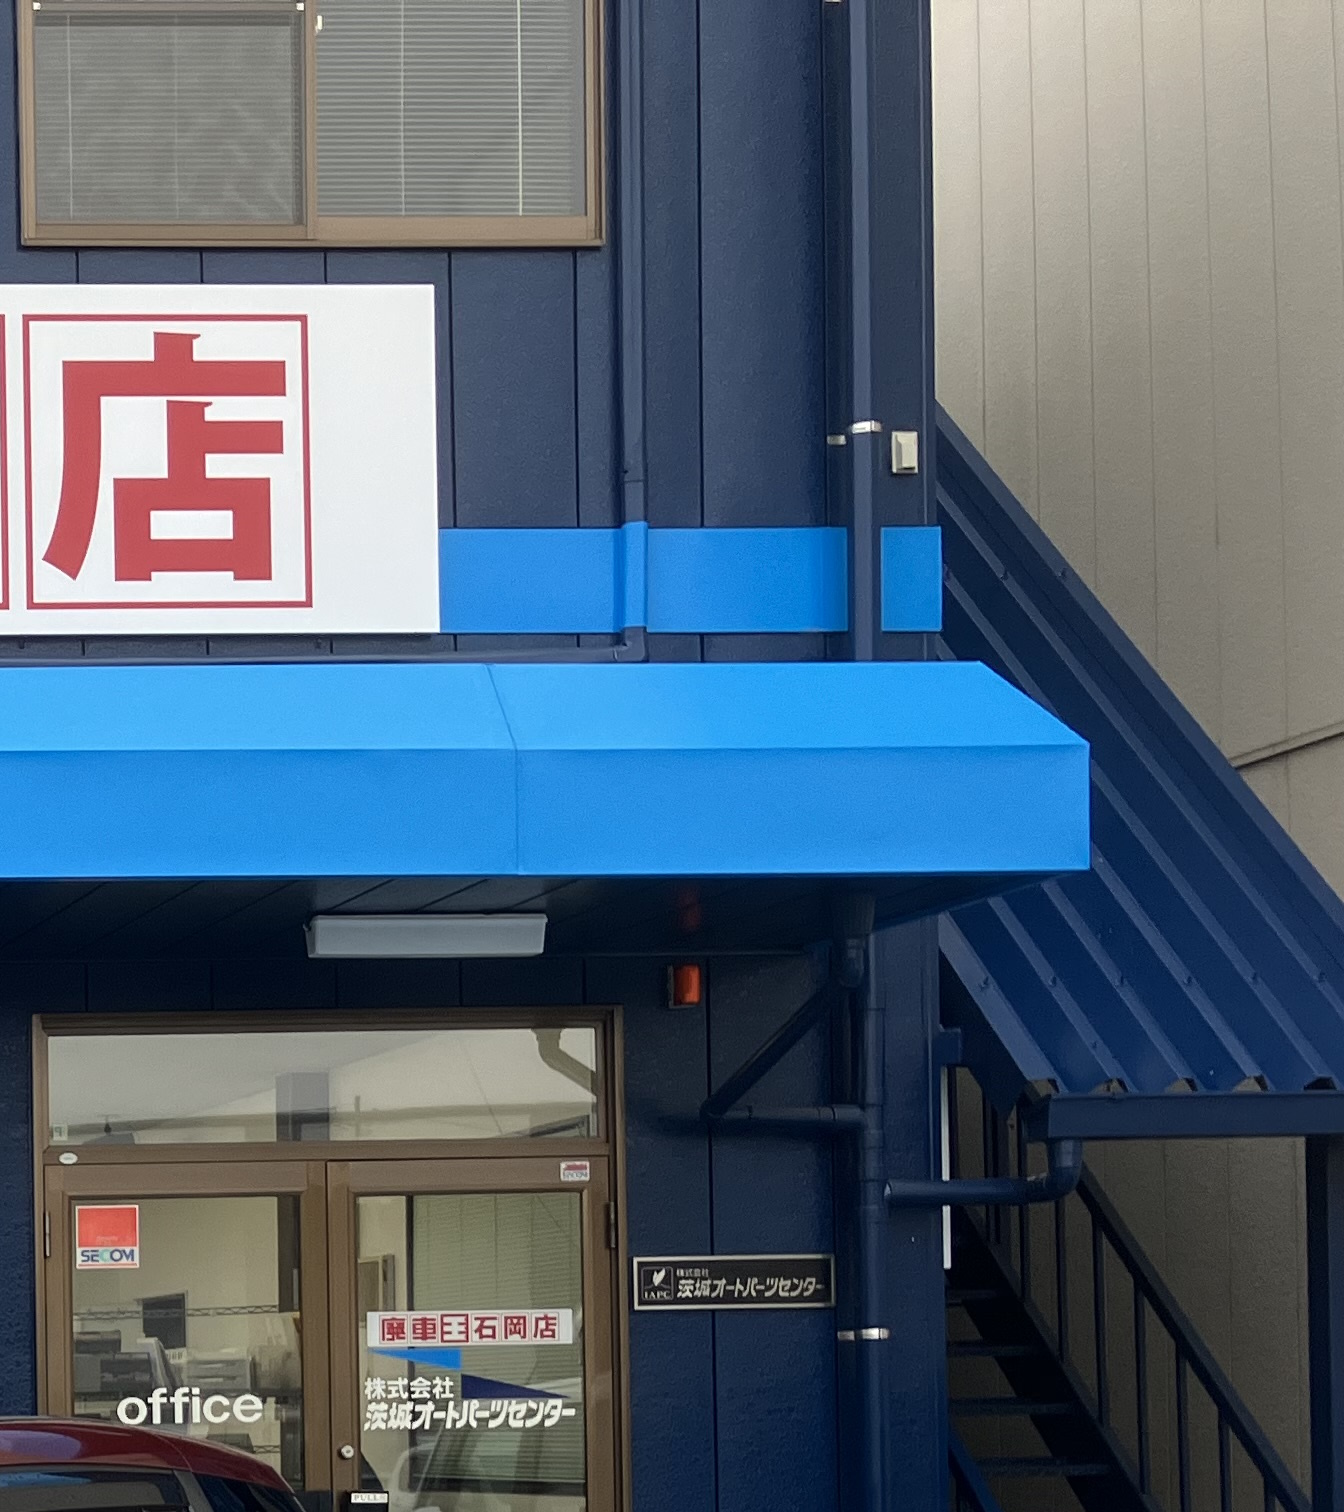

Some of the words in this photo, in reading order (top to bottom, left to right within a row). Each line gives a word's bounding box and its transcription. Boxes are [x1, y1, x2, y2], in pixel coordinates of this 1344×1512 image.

[80, 1249, 135, 1263] SECOM
[676, 1277, 825, 1299] 茨城オートパーツセンター
[381, 1314, 558, 1343] 廃車王石岡店
[363, 1377, 455, 1400] 株式会社
[117, 1387, 263, 1425] office
[363, 1400, 576, 1432] 茨城オートパーツセンター
